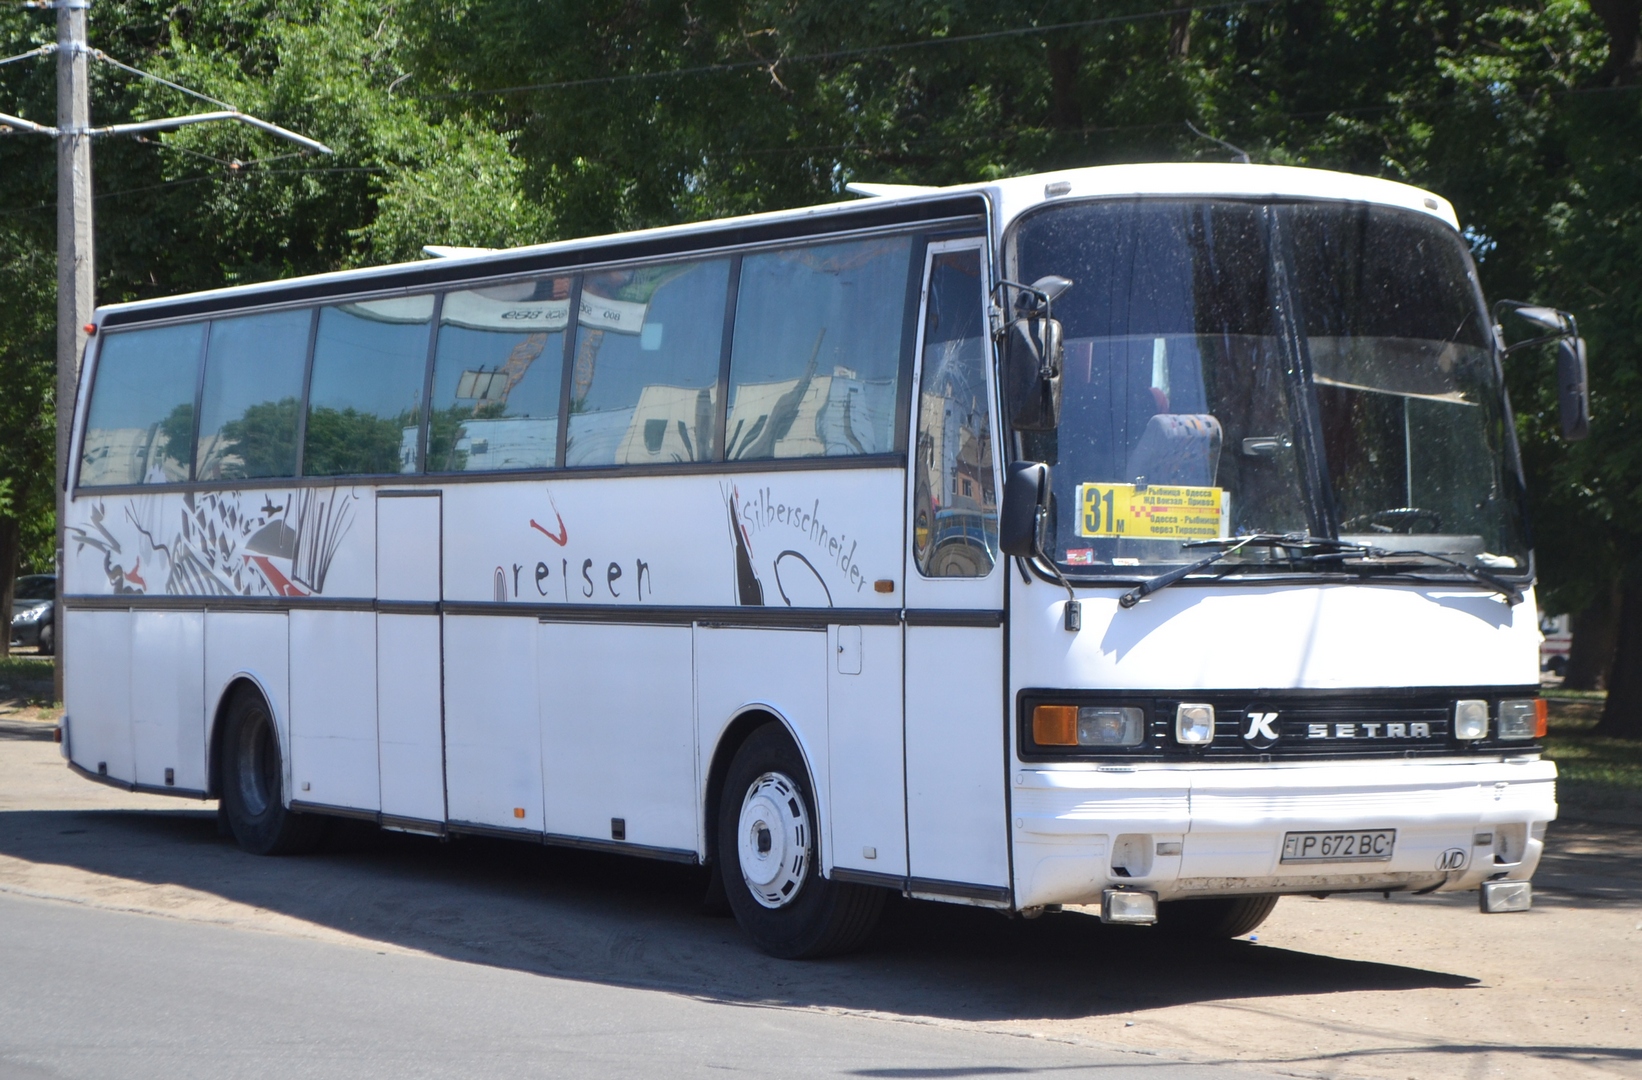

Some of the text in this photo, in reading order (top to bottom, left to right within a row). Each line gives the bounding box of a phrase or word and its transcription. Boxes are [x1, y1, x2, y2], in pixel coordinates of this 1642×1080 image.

[1148, 487, 1181, 497] Рыбница
[1185, 489, 1212, 498] Одесса
[1085, 488, 1114, 533] 31
[1150, 514, 1178, 524] Одесса
[1150, 526, 1174, 534] через
[512, 558, 651, 602] reisen
[1307, 722, 1431, 739] SETRA
[1321, 835, 1355, 856] 672
[1358, 834, 1386, 855] BC
[1438, 850, 1466, 871] MD
